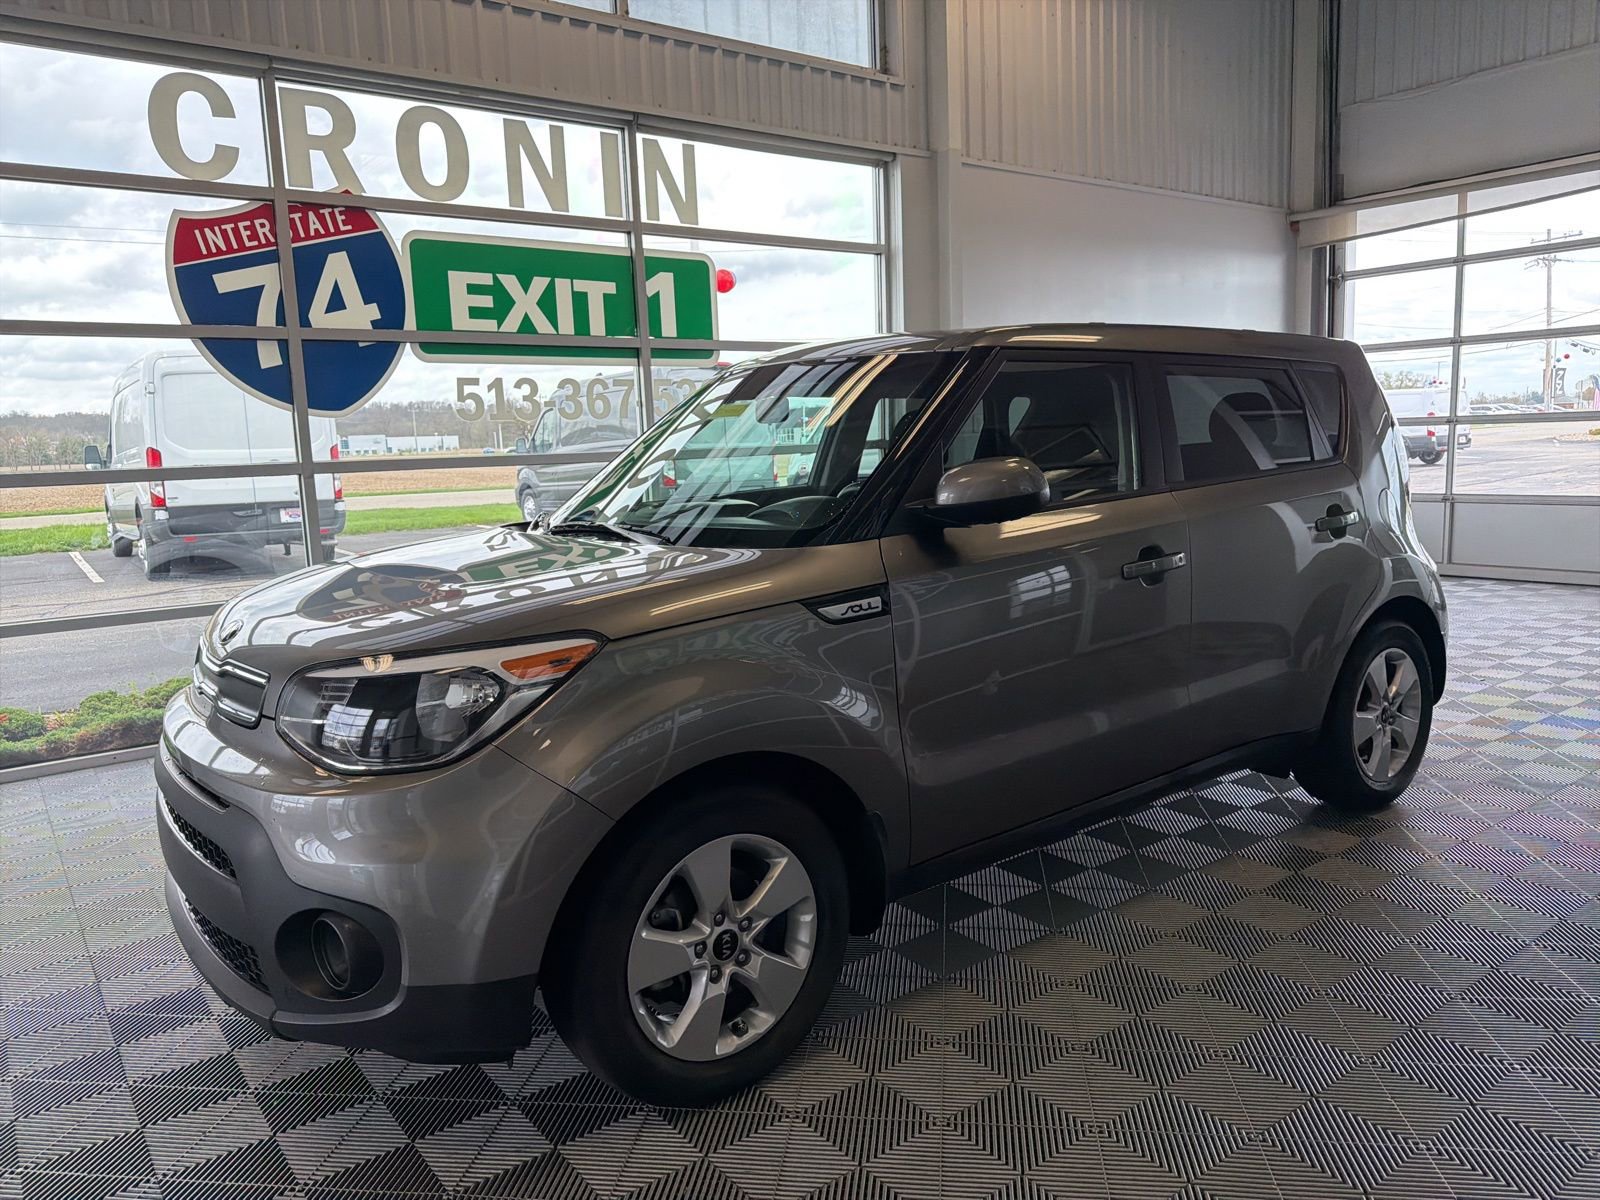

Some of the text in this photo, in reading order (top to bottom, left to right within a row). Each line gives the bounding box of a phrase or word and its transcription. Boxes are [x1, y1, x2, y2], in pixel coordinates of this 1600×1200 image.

[147, 72, 699, 226] CRONIN
[193, 207, 353, 255] INTERTATE
[211, 250, 382, 370] 74
[447, 270, 678, 338] EXIT 1
